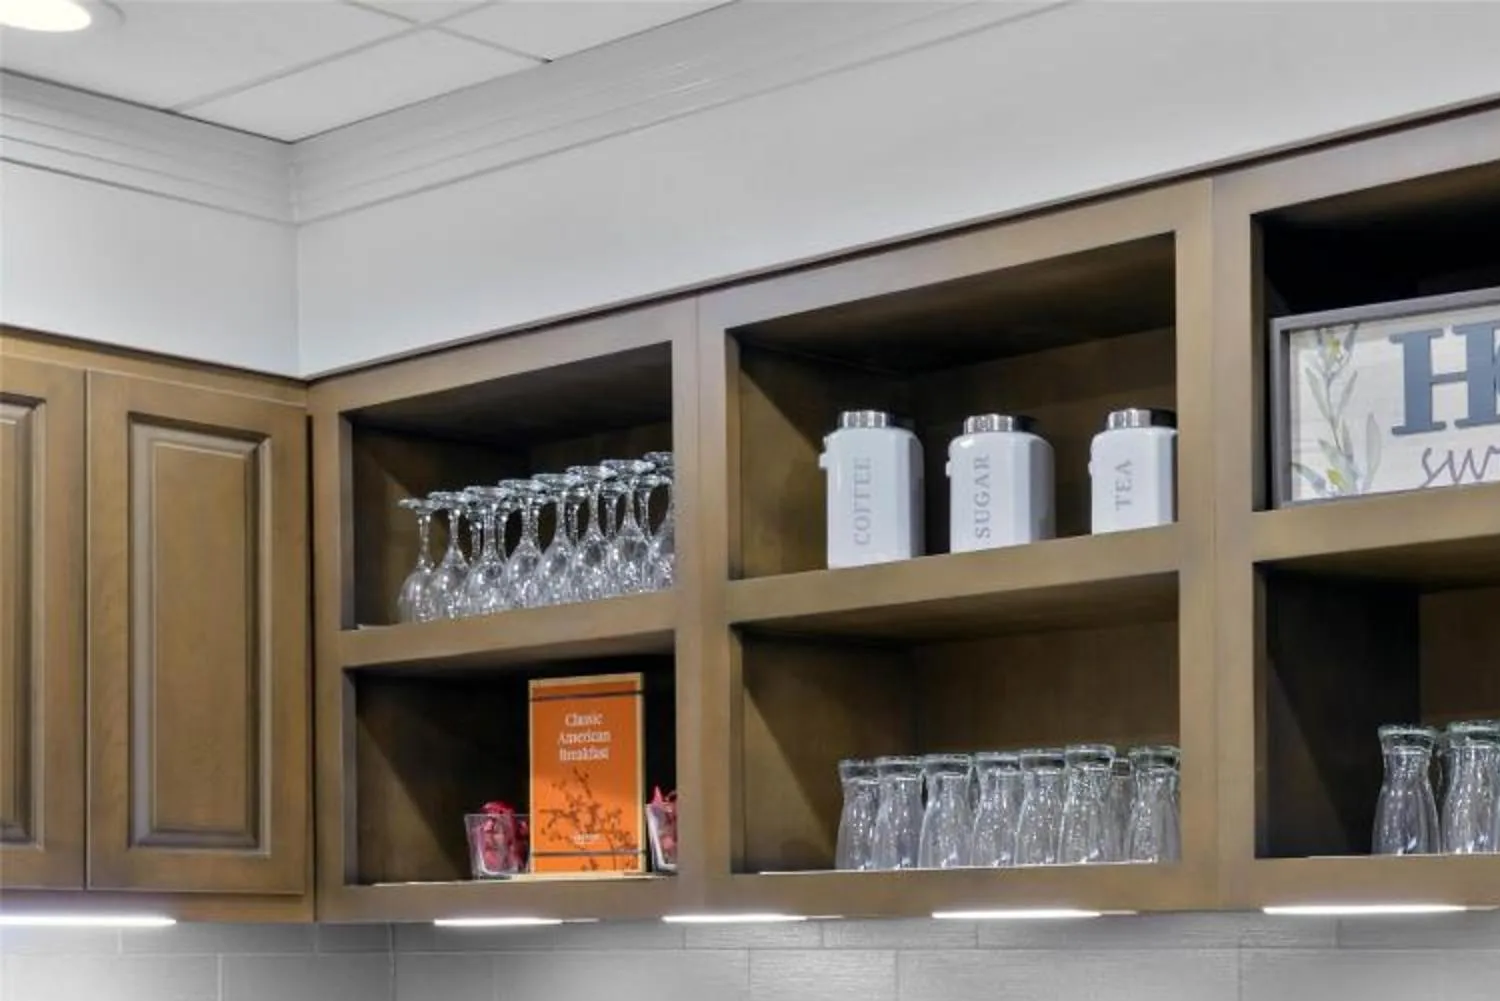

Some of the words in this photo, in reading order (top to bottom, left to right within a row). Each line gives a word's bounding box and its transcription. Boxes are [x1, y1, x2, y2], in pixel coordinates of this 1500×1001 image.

[852, 456, 872, 546] COFFEE
[973, 454, 991, 538] SUGAR
[1114, 458, 1133, 511] TEA
[558, 730, 611, 745] American
[559, 746, 609, 762] Breakfast
